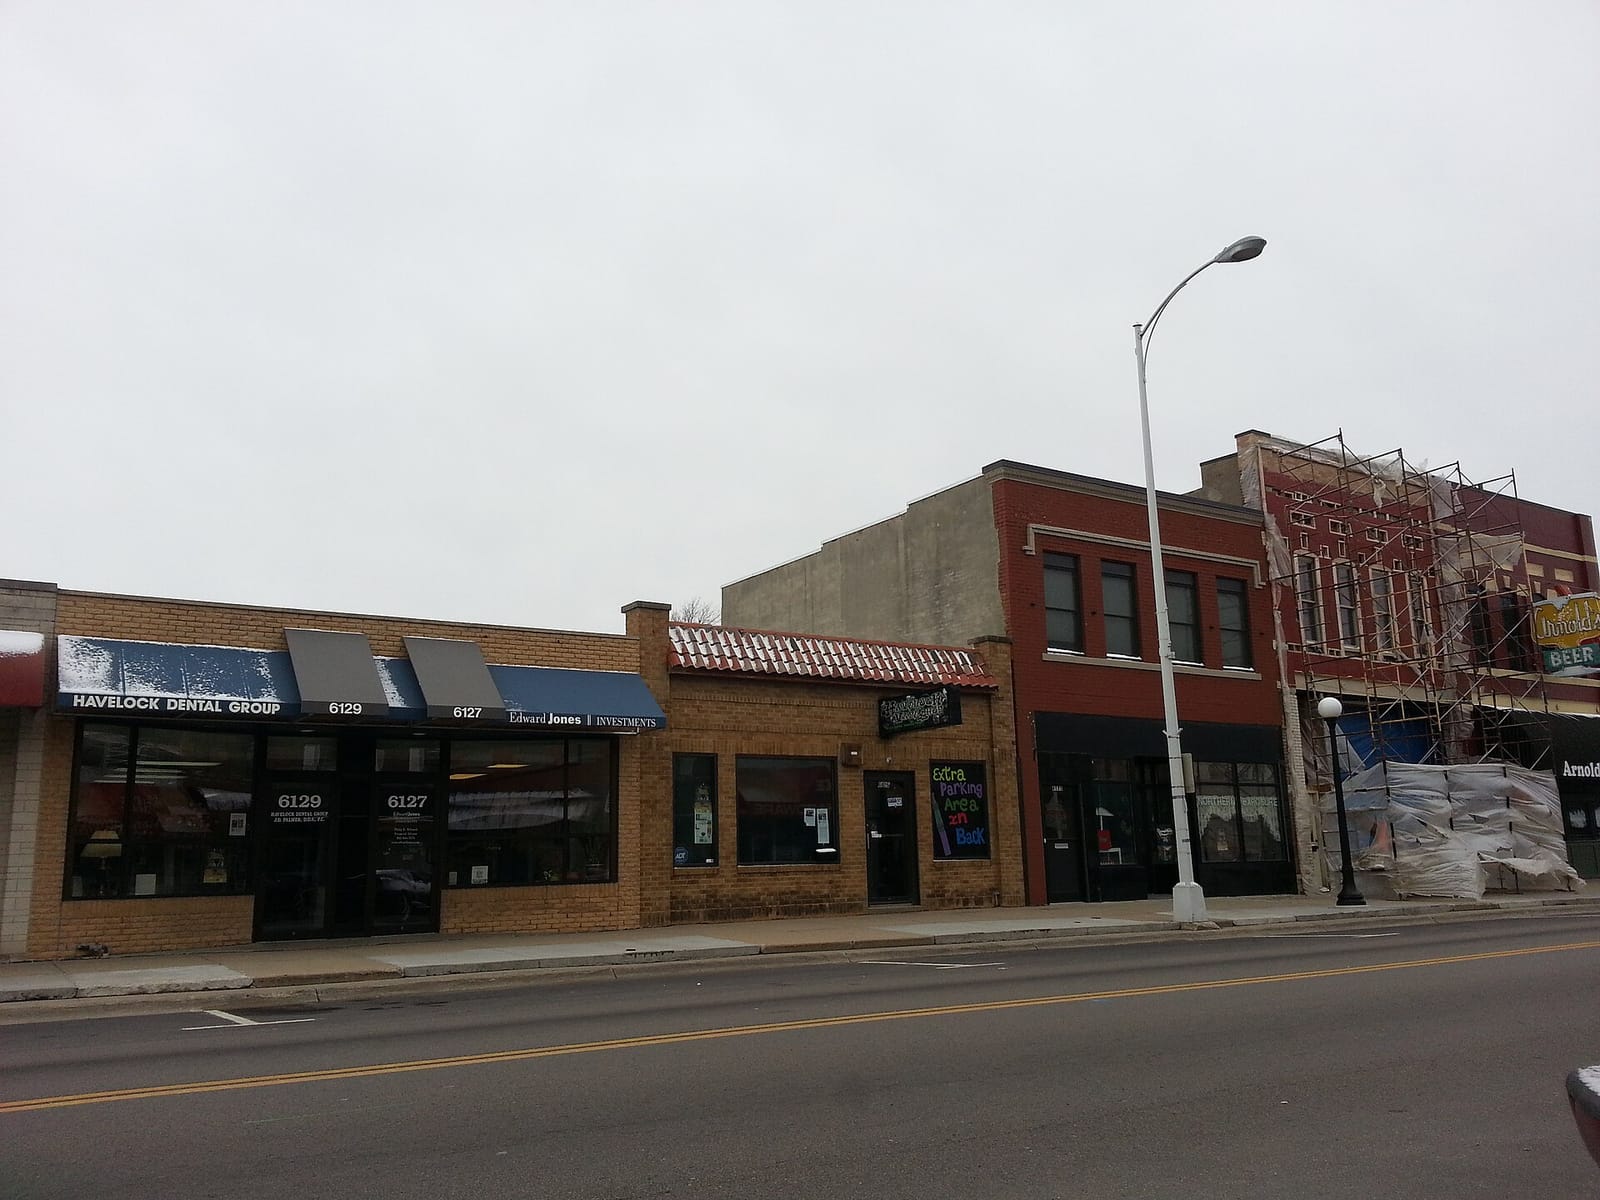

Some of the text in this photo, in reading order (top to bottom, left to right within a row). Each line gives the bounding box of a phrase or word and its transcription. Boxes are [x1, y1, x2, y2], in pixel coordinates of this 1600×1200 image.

[1550, 647, 1594, 667] BEER
[72, 694, 281, 715] HAVELOCK DENTAL GROUP
[329, 702, 363, 715] 6129
[453, 706, 482, 718] 6127
[509, 712, 657, 728] Edward Jones INVESTMENTS
[932, 766, 967, 782] Extra
[278, 794, 322, 808] 6129
[388, 795, 428, 808] 6127
[944, 798, 979, 812] Area
[955, 827, 986, 846] Back
